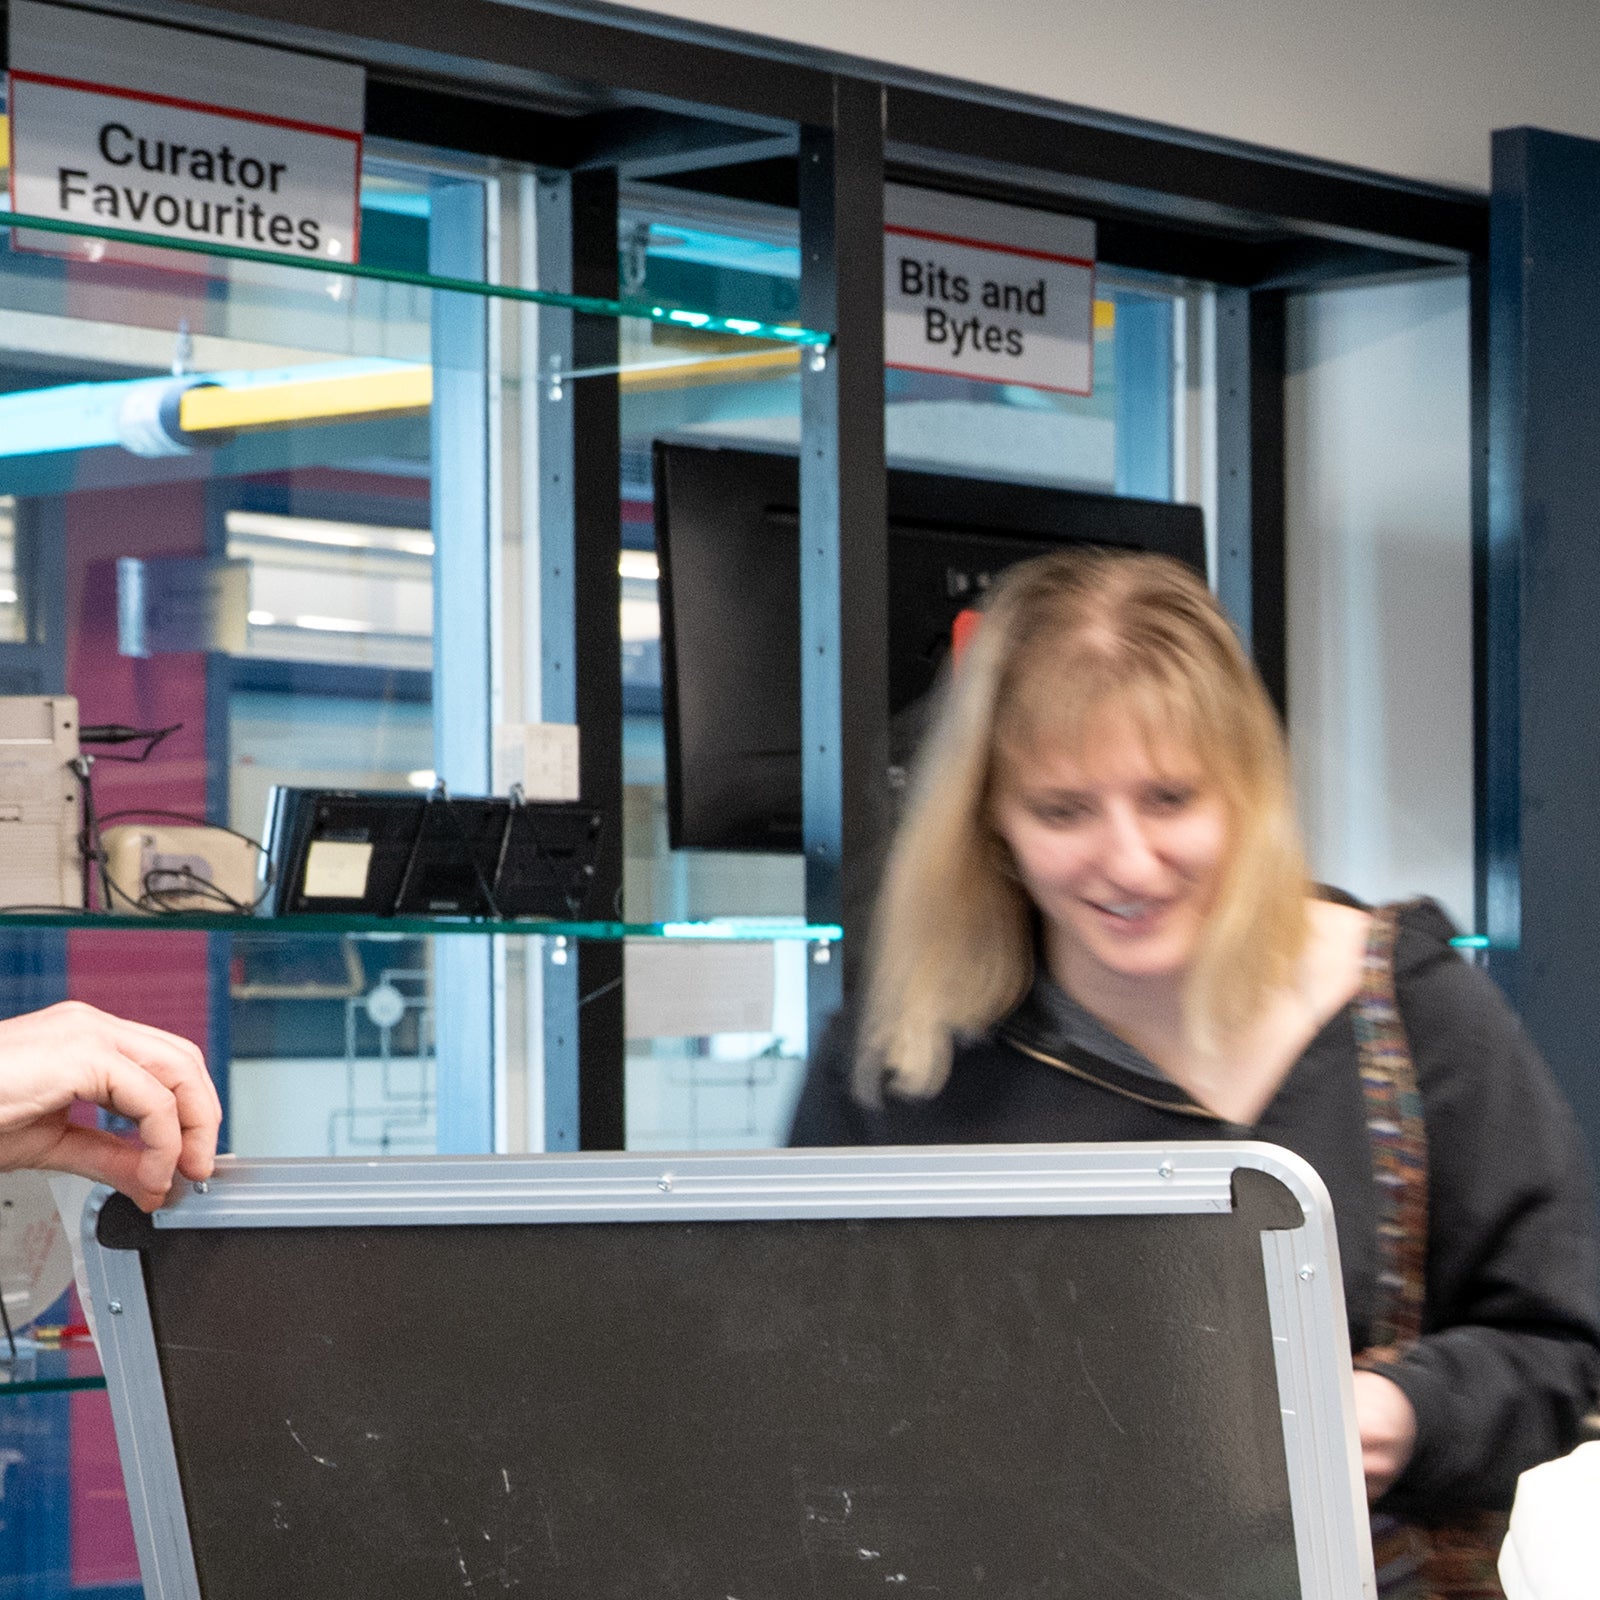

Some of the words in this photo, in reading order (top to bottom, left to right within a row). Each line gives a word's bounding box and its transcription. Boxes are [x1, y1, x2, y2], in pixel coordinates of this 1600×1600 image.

[99, 122, 287, 193] Curator
[58, 167, 321, 251] Favourites
[901, 257, 969, 303] Bits
[982, 279, 1046, 316] and
[926, 308, 1023, 358] Bytes
